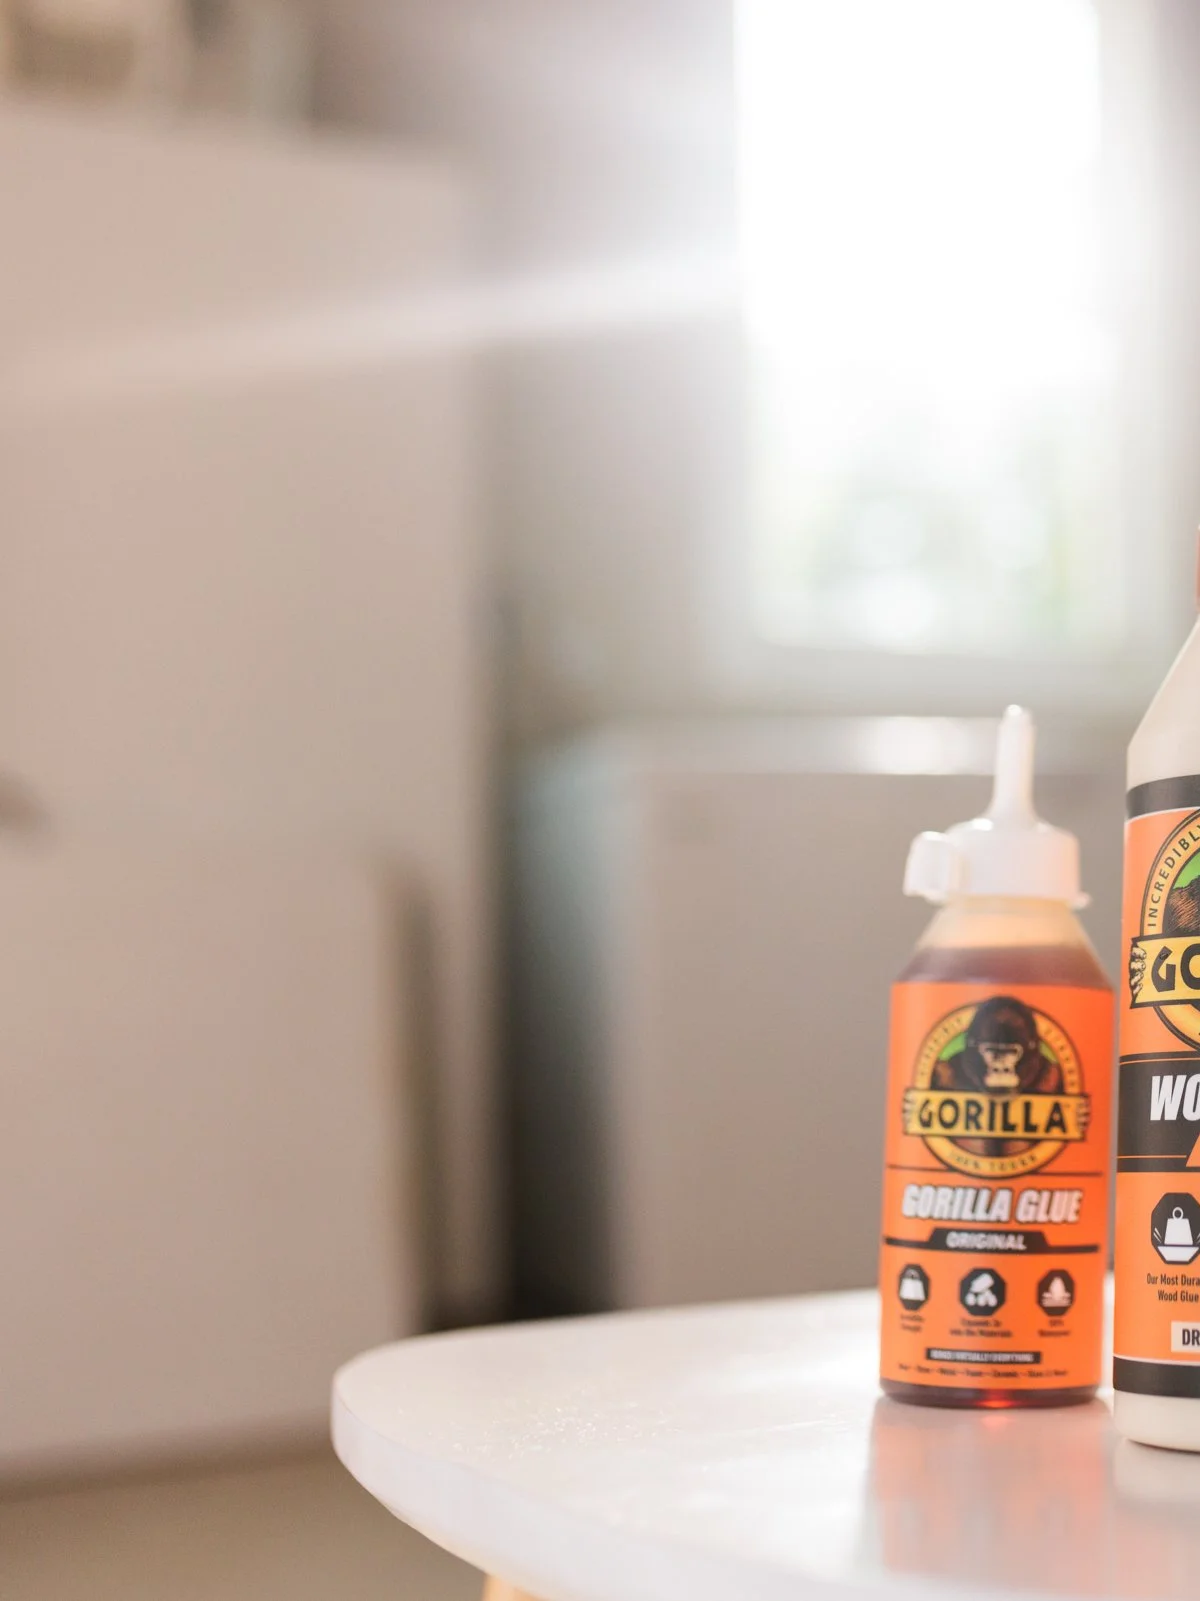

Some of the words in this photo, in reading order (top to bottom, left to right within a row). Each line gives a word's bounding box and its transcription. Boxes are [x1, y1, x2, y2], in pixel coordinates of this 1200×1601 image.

[918, 1098, 1067, 1134] GORILLA
[902, 1184, 1014, 1223] GORILLA
[1015, 1188, 1084, 1224] GLUE
[946, 1231, 1028, 1250] ORIGINAL
[1146, 1273, 1159, 1286] Our
[1160, 1273, 1179, 1286] Most
[1158, 1290, 1178, 1302] Wood
[1179, 1290, 1199, 1303] Glue
